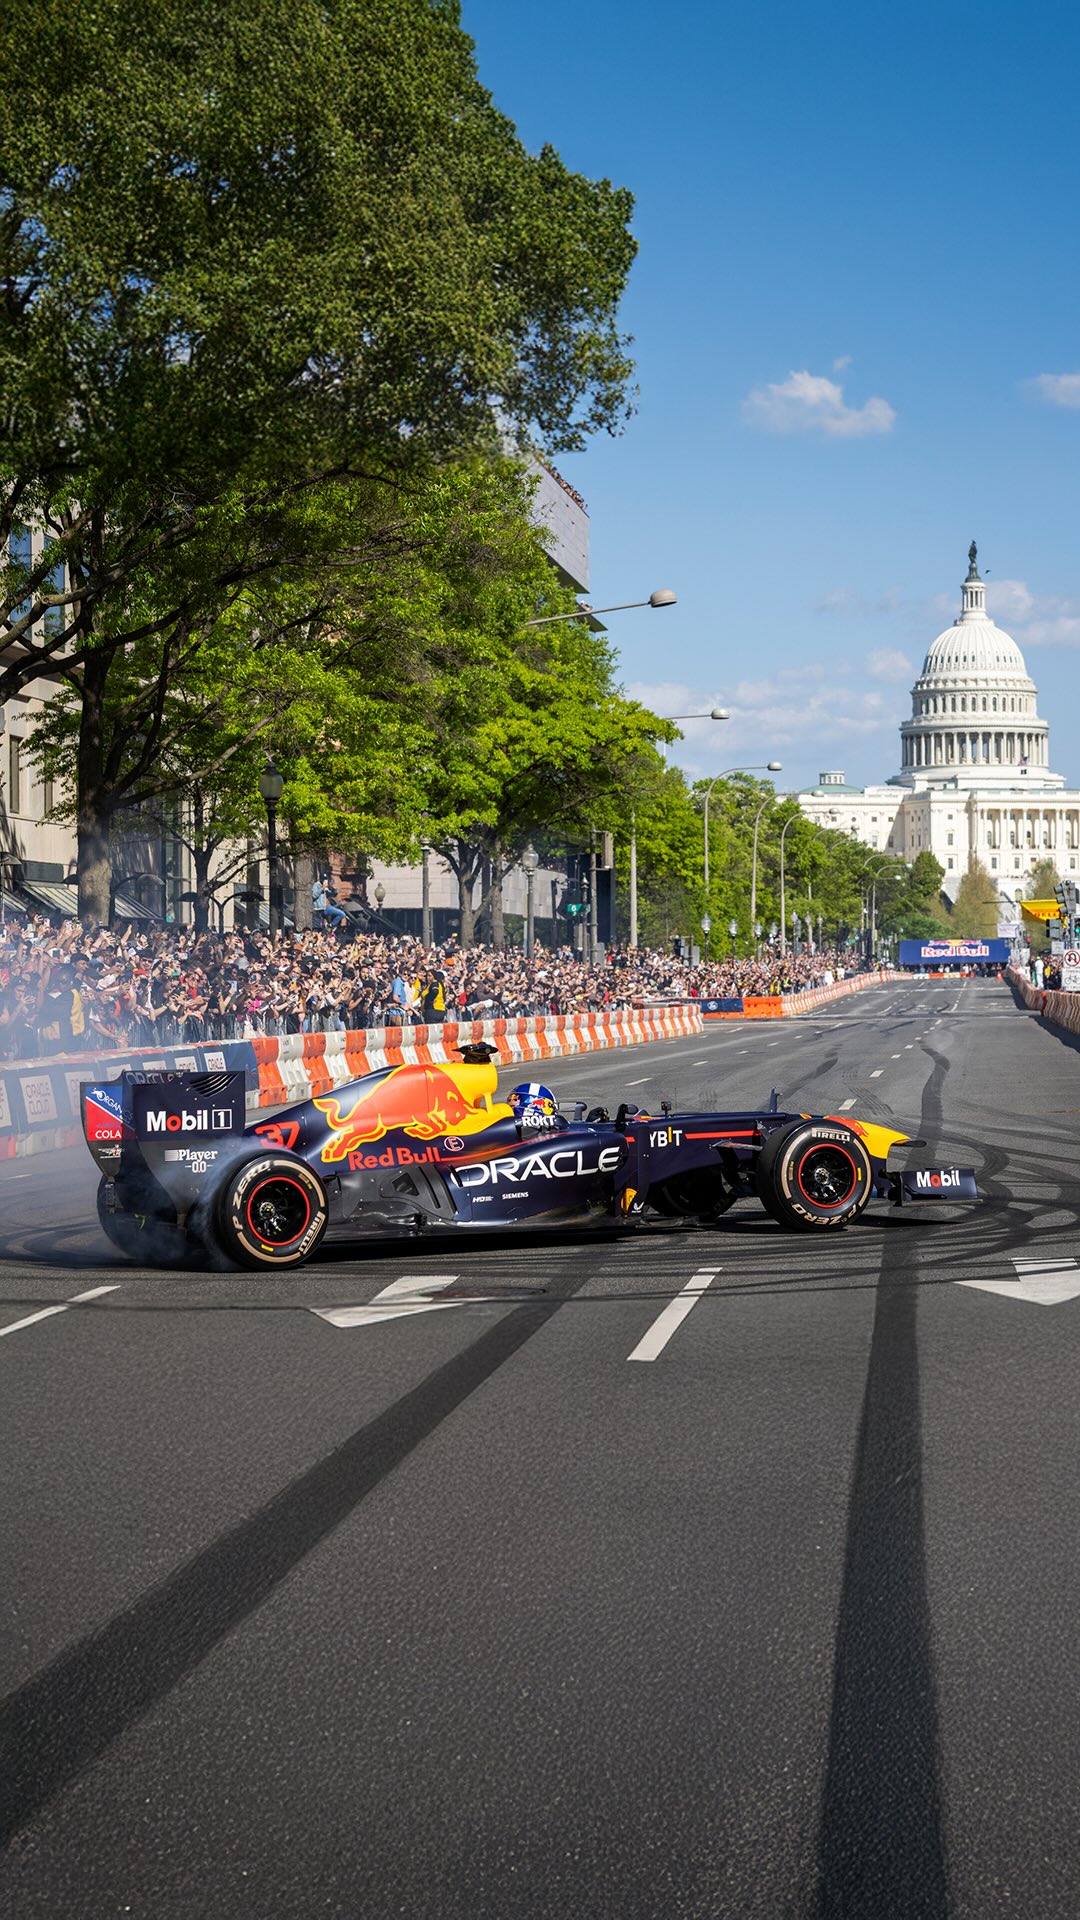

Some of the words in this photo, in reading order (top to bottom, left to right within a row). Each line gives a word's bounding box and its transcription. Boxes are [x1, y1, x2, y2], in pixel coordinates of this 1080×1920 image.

[922, 946, 955, 957] Red
[957, 945, 989, 956] Bull
[147, 1109, 208, 1132] Mobil
[521, 1115, 556, 1127] ROKT
[95, 1130, 122, 1139] COLA
[255, 1120, 300, 1149] 37
[811, 1127, 851, 1142] PIRELLI
[178, 1149, 218, 1162] Player
[347, 1149, 394, 1171] Red
[396, 1147, 440, 1166] Bull
[450, 1146, 621, 1188] ORACLE
[232, 1159, 272, 1210] ZERO
[916, 1169, 962, 1188] Mobil
[501, 1191, 529, 1200] SIEMENS
[231, 1215, 244, 1231] P
[791, 1202, 843, 1225] ZERO
[298, 1210, 327, 1255] PIRELLI
